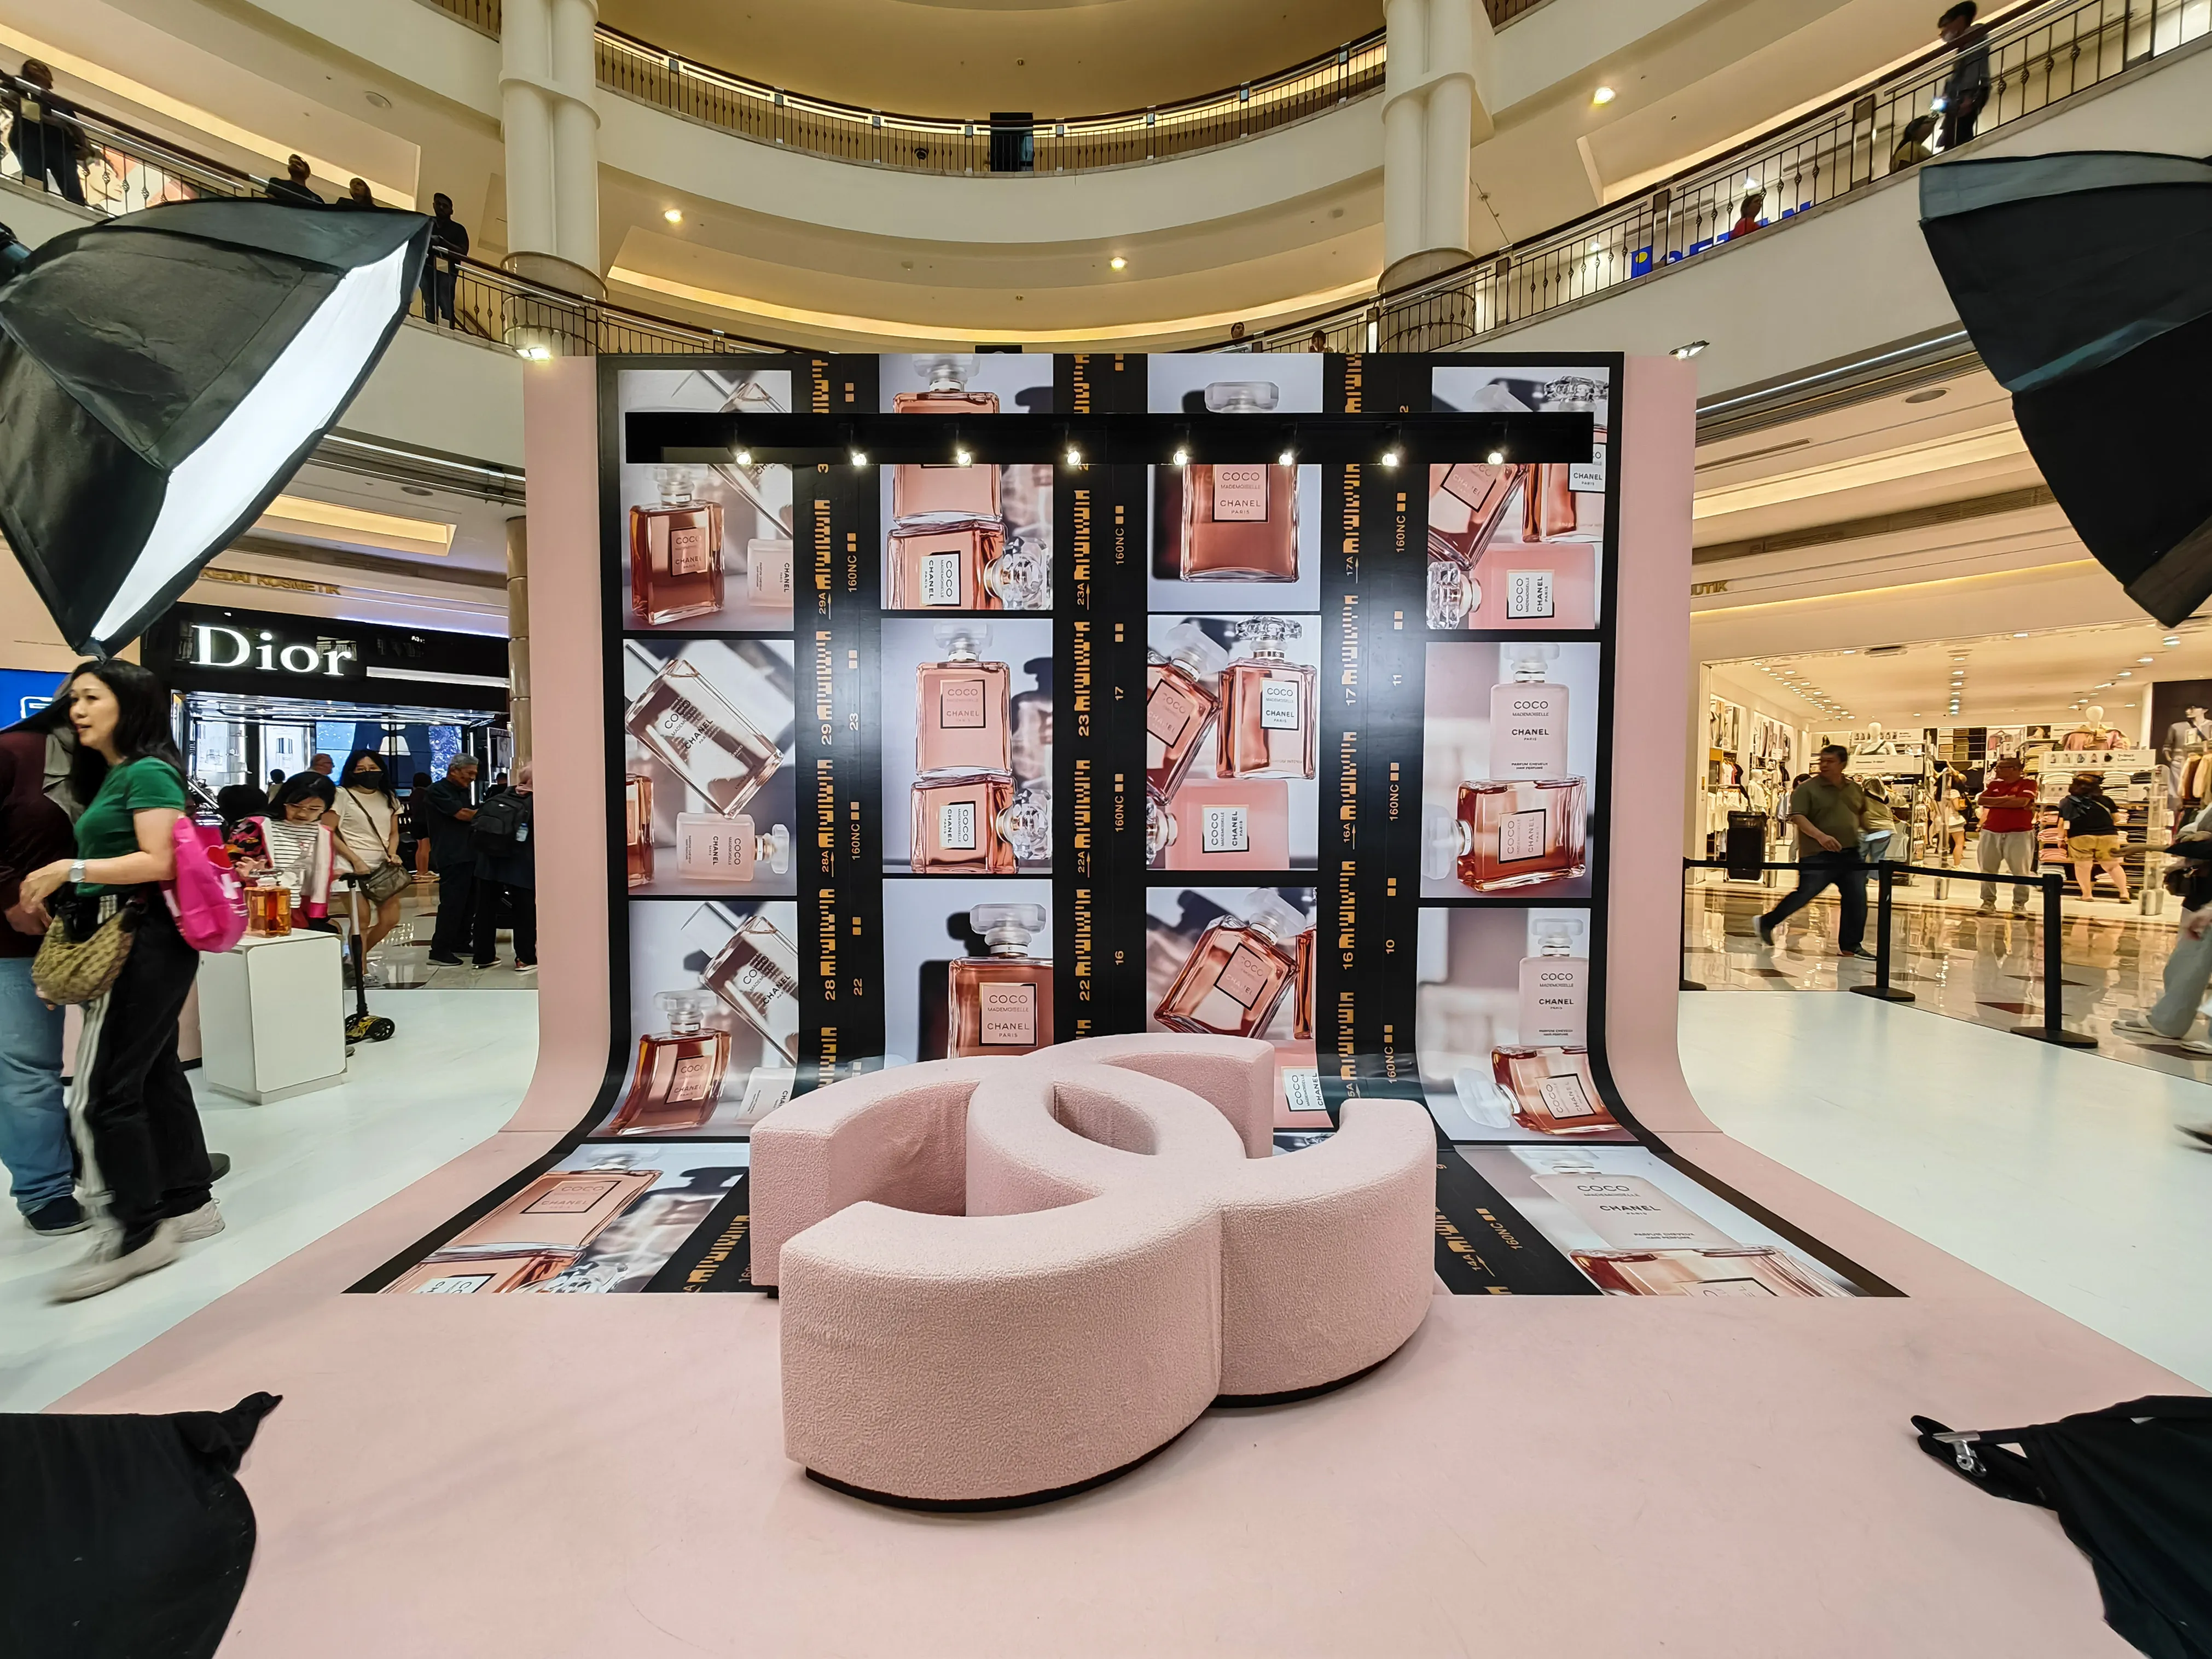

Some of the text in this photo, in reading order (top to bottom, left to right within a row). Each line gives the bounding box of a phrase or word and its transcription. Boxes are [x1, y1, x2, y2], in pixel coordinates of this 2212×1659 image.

[1222, 472, 1259, 481] COCO
[1574, 472, 1603, 480] CHANEL
[1396, 515, 1406, 552] 160NC
[1116, 528, 1124, 565] 160NC
[847, 555, 857, 593] 160NC
[1077, 583, 1085, 605] 23A
[1691, 580, 1728, 596] UTIK
[189, 624, 352, 676] Dior
[1392, 674, 1402, 686] 11
[1115, 687, 1124, 700] 17
[1267, 687, 1293, 697] COCO
[1345, 688, 1356, 706] 17
[1514, 701, 1548, 709] COCO
[849, 712, 859, 731] 23
[1078, 714, 1089, 736] 23
[685, 719, 713, 750] CHANEL
[821, 723, 833, 746] 29
[1116, 795, 1124, 832] 160NC
[1390, 784, 1399, 821] 160NC
[851, 823, 861, 860] 160NC
[1343, 822, 1351, 843] 16A
[821, 850, 829, 873] 28A
[1077, 851, 1085, 873] 22A
[1114, 950, 1124, 965] 16
[1385, 939, 1395, 954] 10
[1343, 952, 1354, 970] 16
[763, 974, 791, 1005] CHANEL
[825, 979, 836, 1001] 28
[854, 978, 863, 996] 22
[1079, 980, 1090, 1001] 22
[989, 995, 1027, 1003] COCO
[1385, 1046, 1397, 1083] 160NC
[1292, 1075, 1304, 1106] COCO
[1311, 1072, 1323, 1106] CHANEL
[1546, 1084, 1564, 1113] COCO
[1565, 1081, 1582, 1112] CHANEL
[1490, 1222, 1523, 1250] 160NC
[1462, 1254, 1482, 1271] 14A
